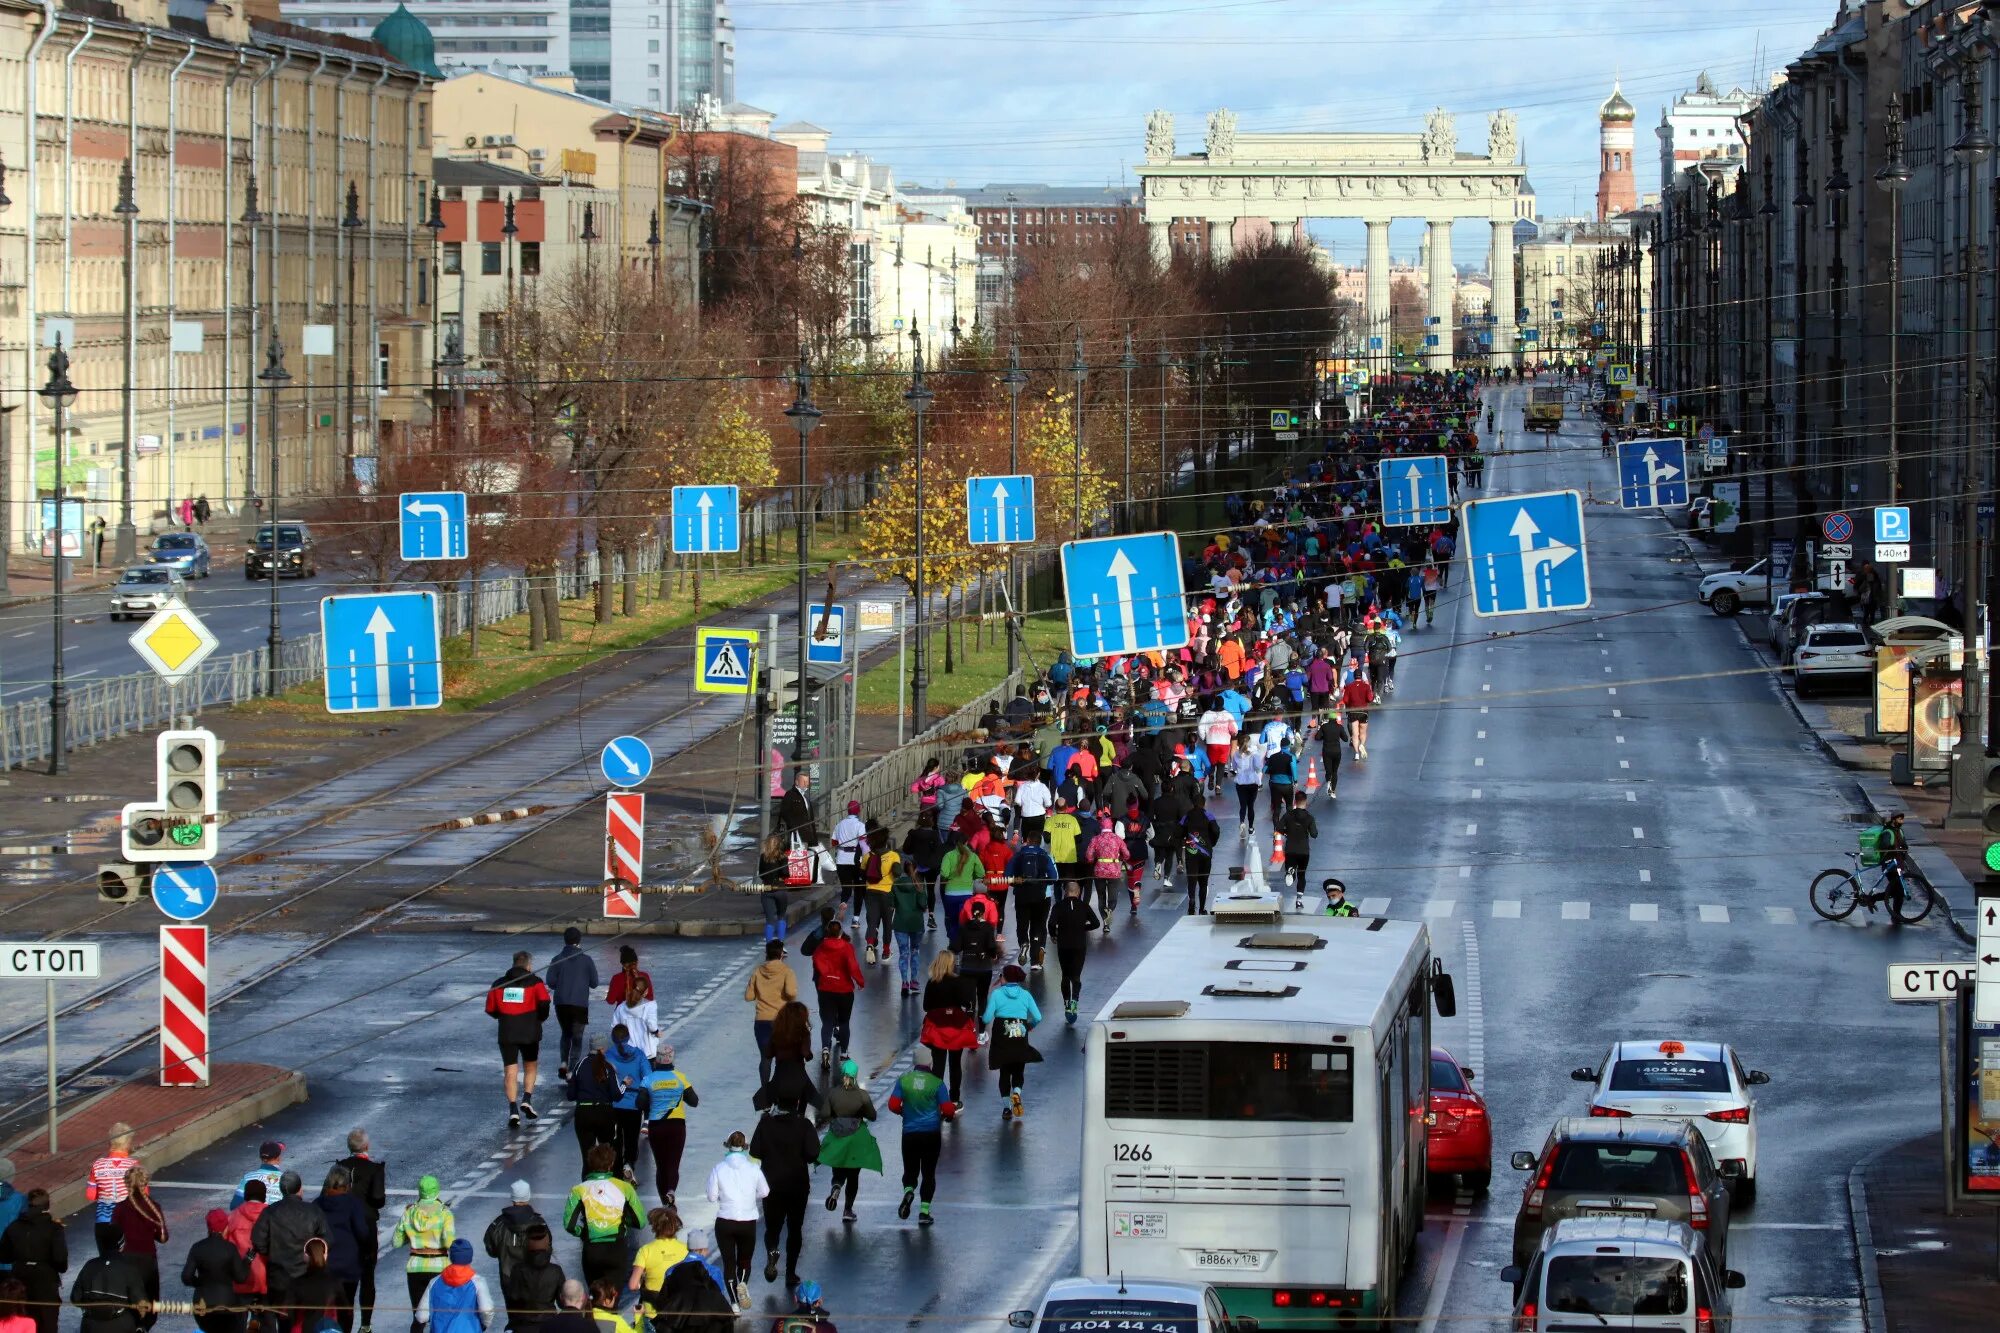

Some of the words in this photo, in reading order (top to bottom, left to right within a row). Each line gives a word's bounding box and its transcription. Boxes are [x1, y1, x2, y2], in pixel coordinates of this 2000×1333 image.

[1881, 511, 1901, 538] P
[1883, 549, 1902, 557] 40м
[772, 737, 795, 745] арту?
[12, 949, 85, 973] СТОП
[1113, 1144, 1153, 1162] 1266
[1070, 1320, 1111, 1331] 404
[1117, 1320, 1145, 1331] 44
[1151, 1323, 1178, 1333] 44
